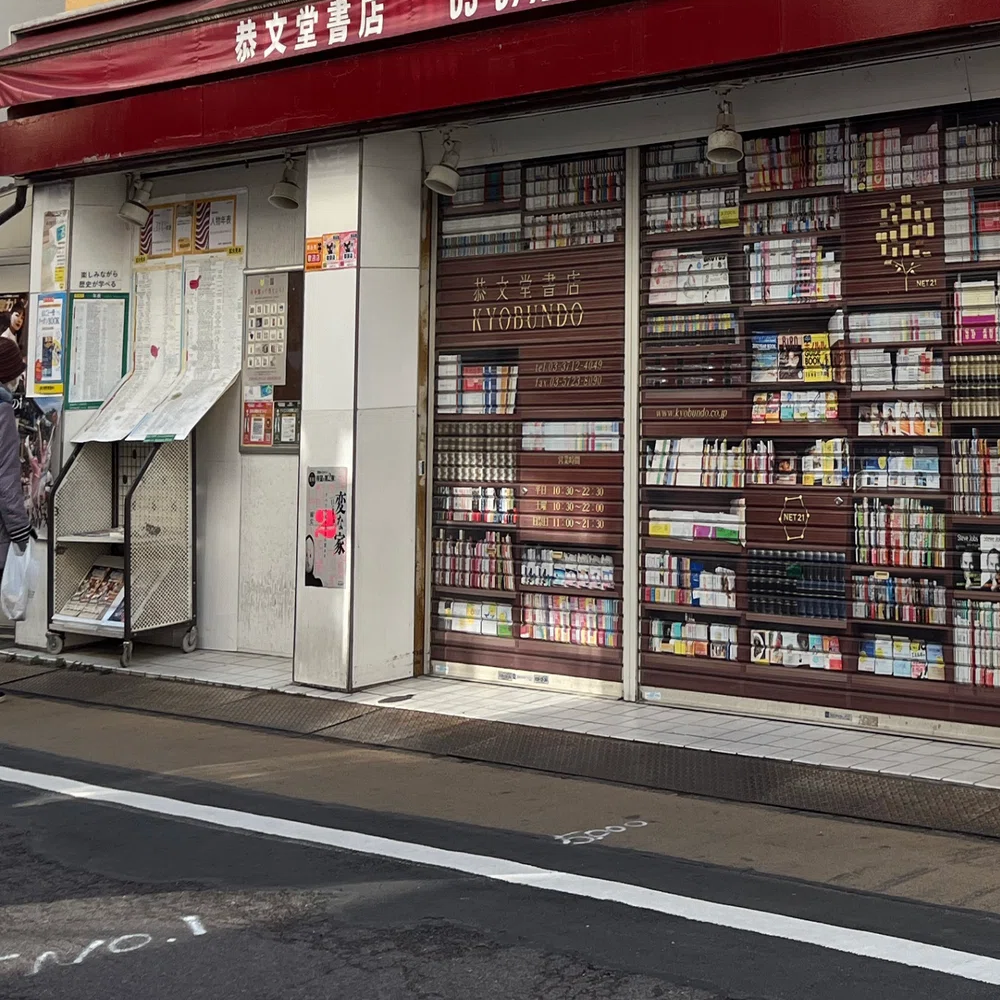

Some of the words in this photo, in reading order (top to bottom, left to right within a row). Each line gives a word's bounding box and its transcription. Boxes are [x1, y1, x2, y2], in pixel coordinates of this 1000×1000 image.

[79, 280, 117, 288] 歴史が学べる
[81, 271, 118, 279] 楽しみながら
[473, 270, 581, 302] 恭文堂書店
[472, 302, 585, 332] KYOBUNDO
[334, 491, 346, 555] 変な家
[783, 513, 805, 522] NET21
